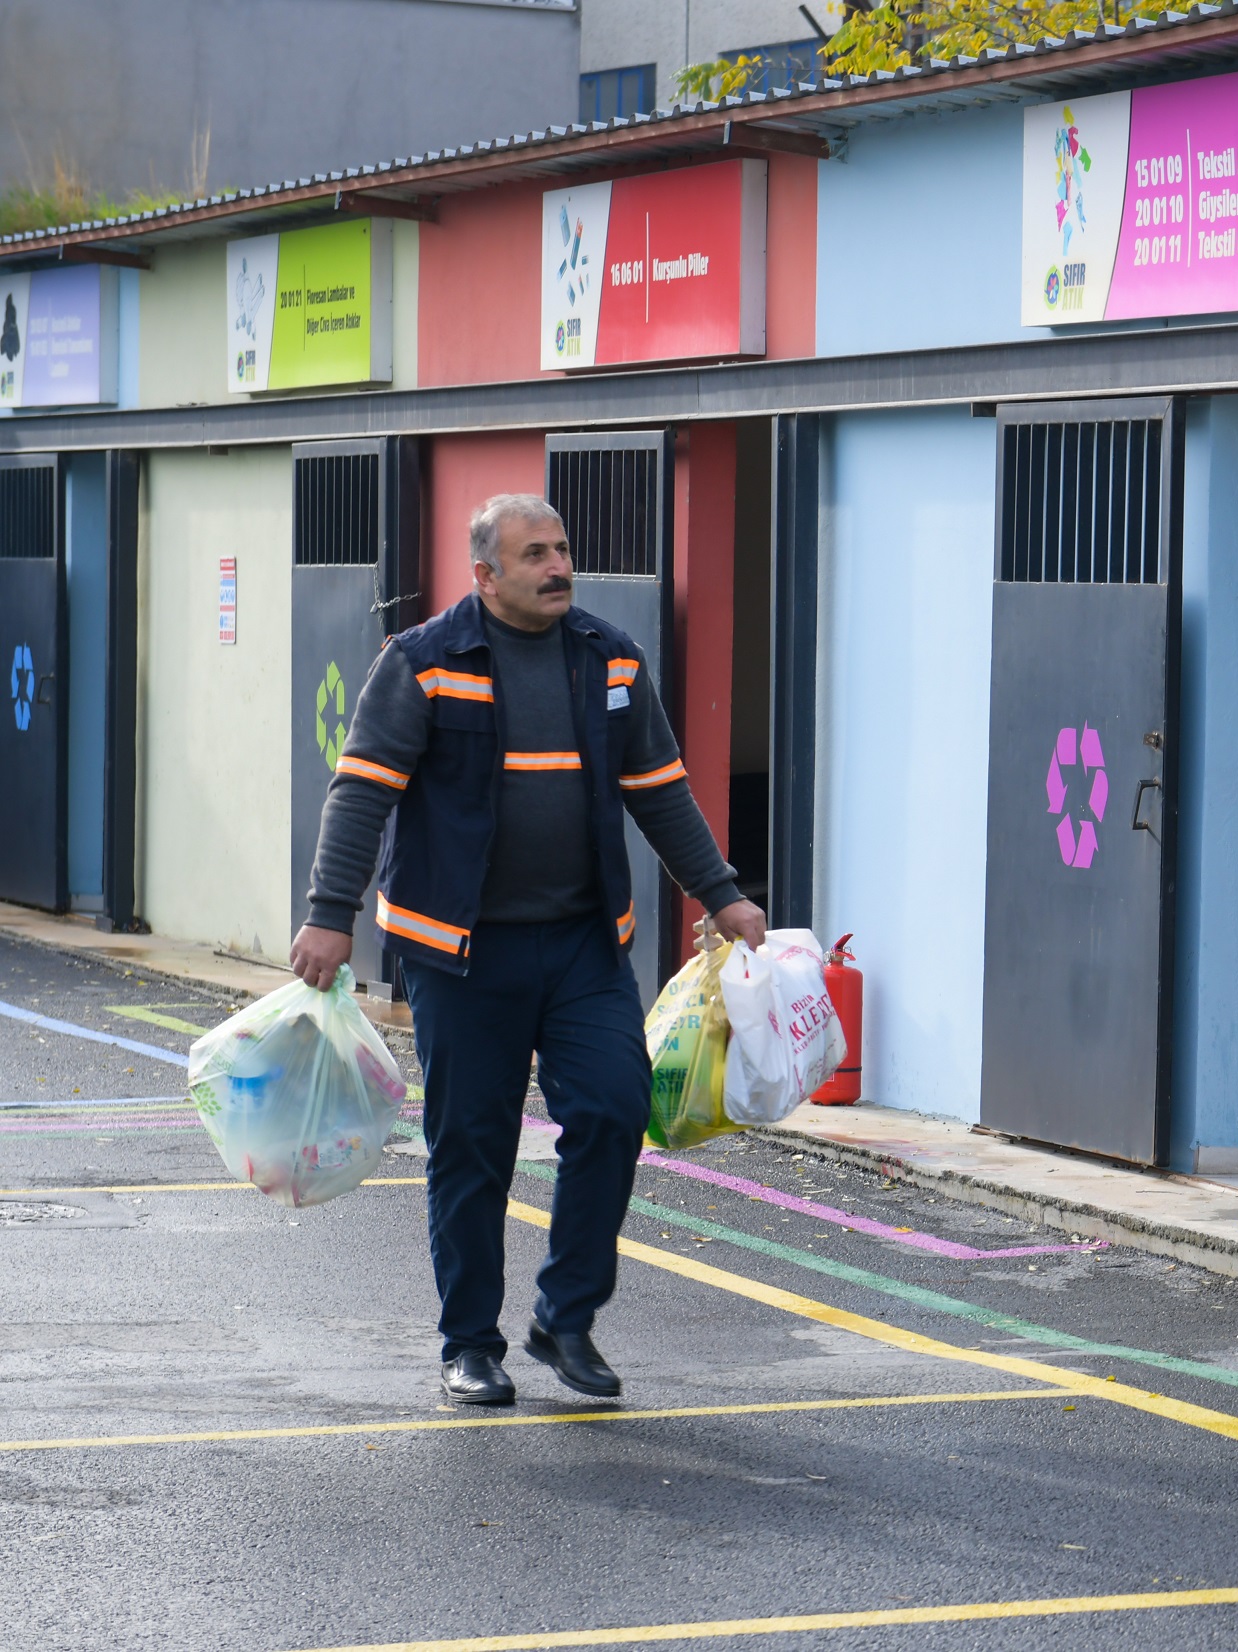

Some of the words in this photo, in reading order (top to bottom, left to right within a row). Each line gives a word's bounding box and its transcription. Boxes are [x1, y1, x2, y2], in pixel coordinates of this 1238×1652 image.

[1135, 159, 1148, 187] 15
[1151, 157, 1164, 186] 01
[1167, 155, 1182, 184] 09
[1197, 147, 1235, 180] Tekstil
[1136, 198, 1150, 227] 20
[1153, 196, 1166, 225] 01
[1170, 194, 1183, 223] 10
[1134, 238, 1149, 266] 20
[1152, 236, 1166, 265] 01
[1169, 234, 1181, 262] 11
[1198, 228, 1235, 259] Tekstil
[611, 263, 620, 286] 16
[621, 261, 632, 285] 06
[633, 260, 643, 284] 01
[653, 255, 687, 284] Kurşunlu
[688, 252, 709, 277] Piller
[1064, 263, 1085, 287] SIFIR
